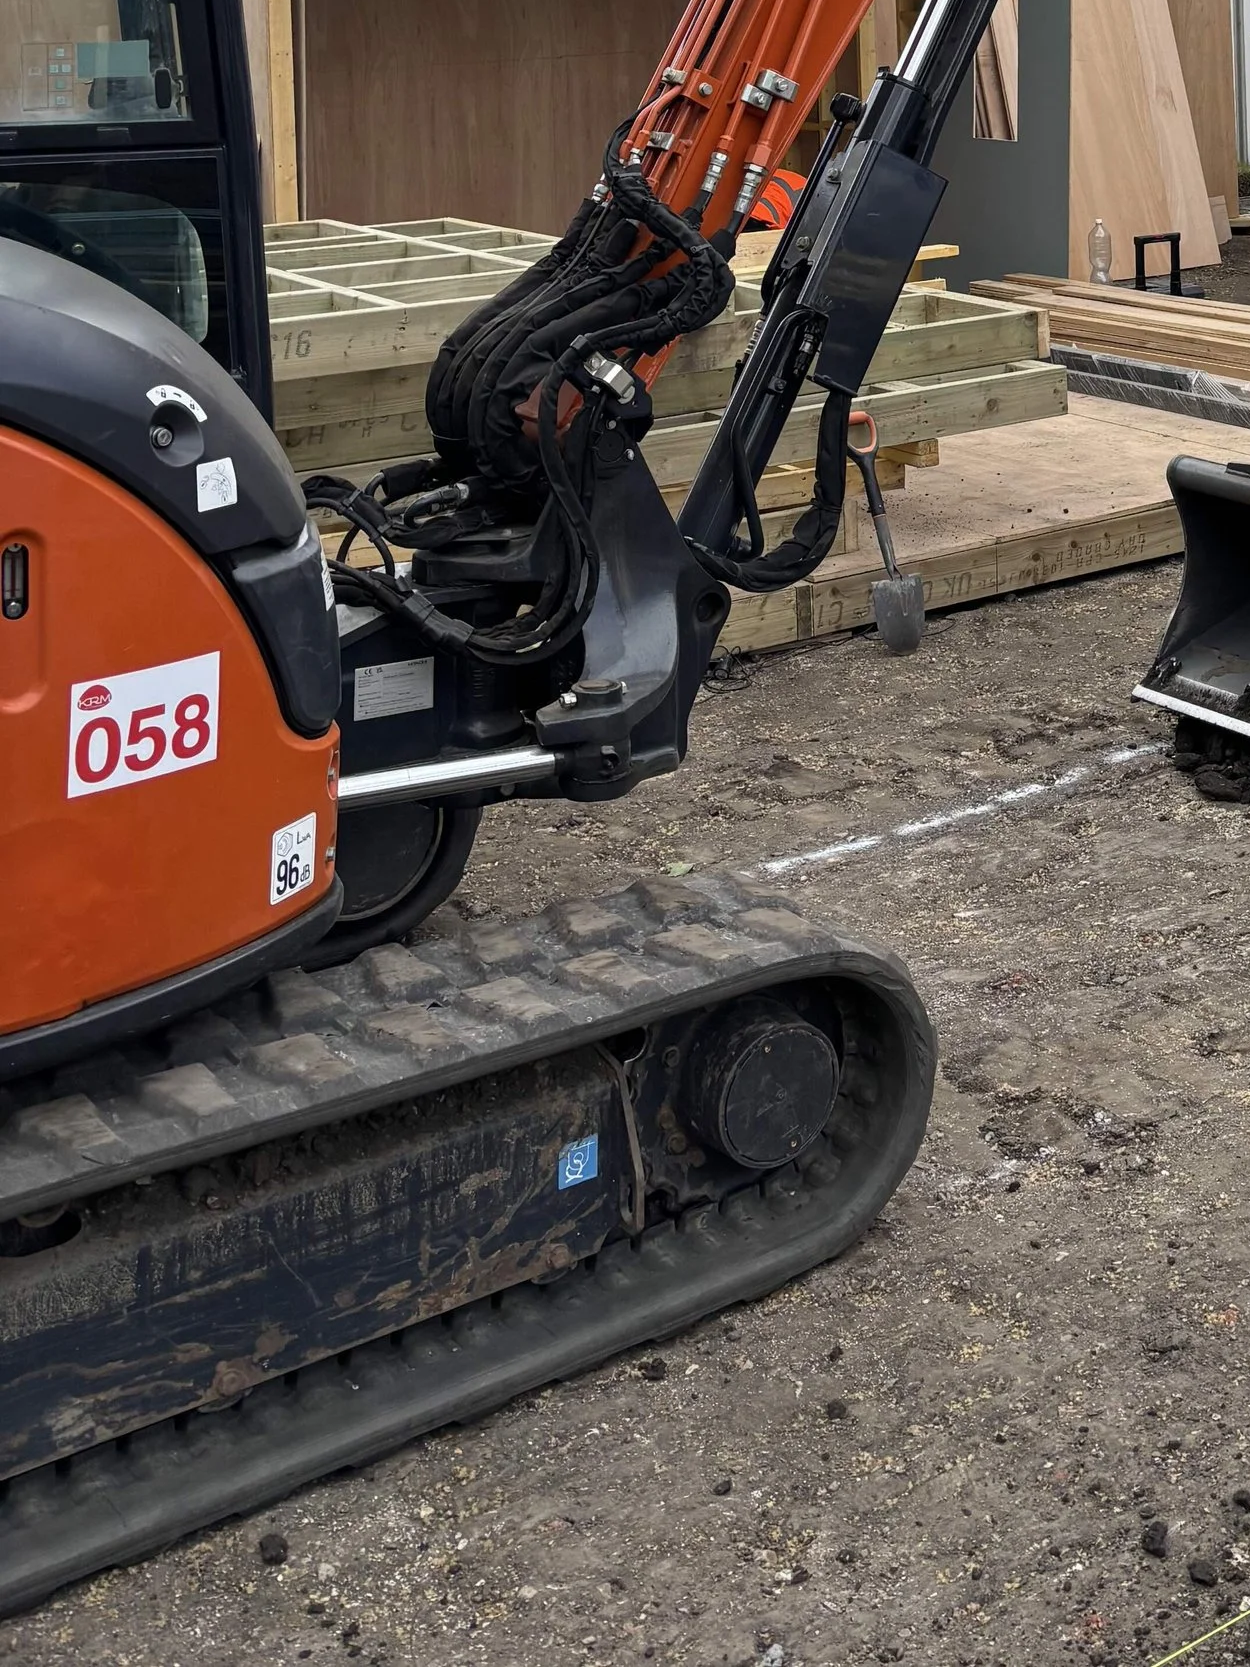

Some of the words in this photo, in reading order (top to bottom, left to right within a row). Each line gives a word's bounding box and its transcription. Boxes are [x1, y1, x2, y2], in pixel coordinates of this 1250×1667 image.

[79, 693, 111, 709] KRM
[75, 693, 211, 784] 058
[276, 853, 300, 896] 96
[300, 863, 311, 883] dB
